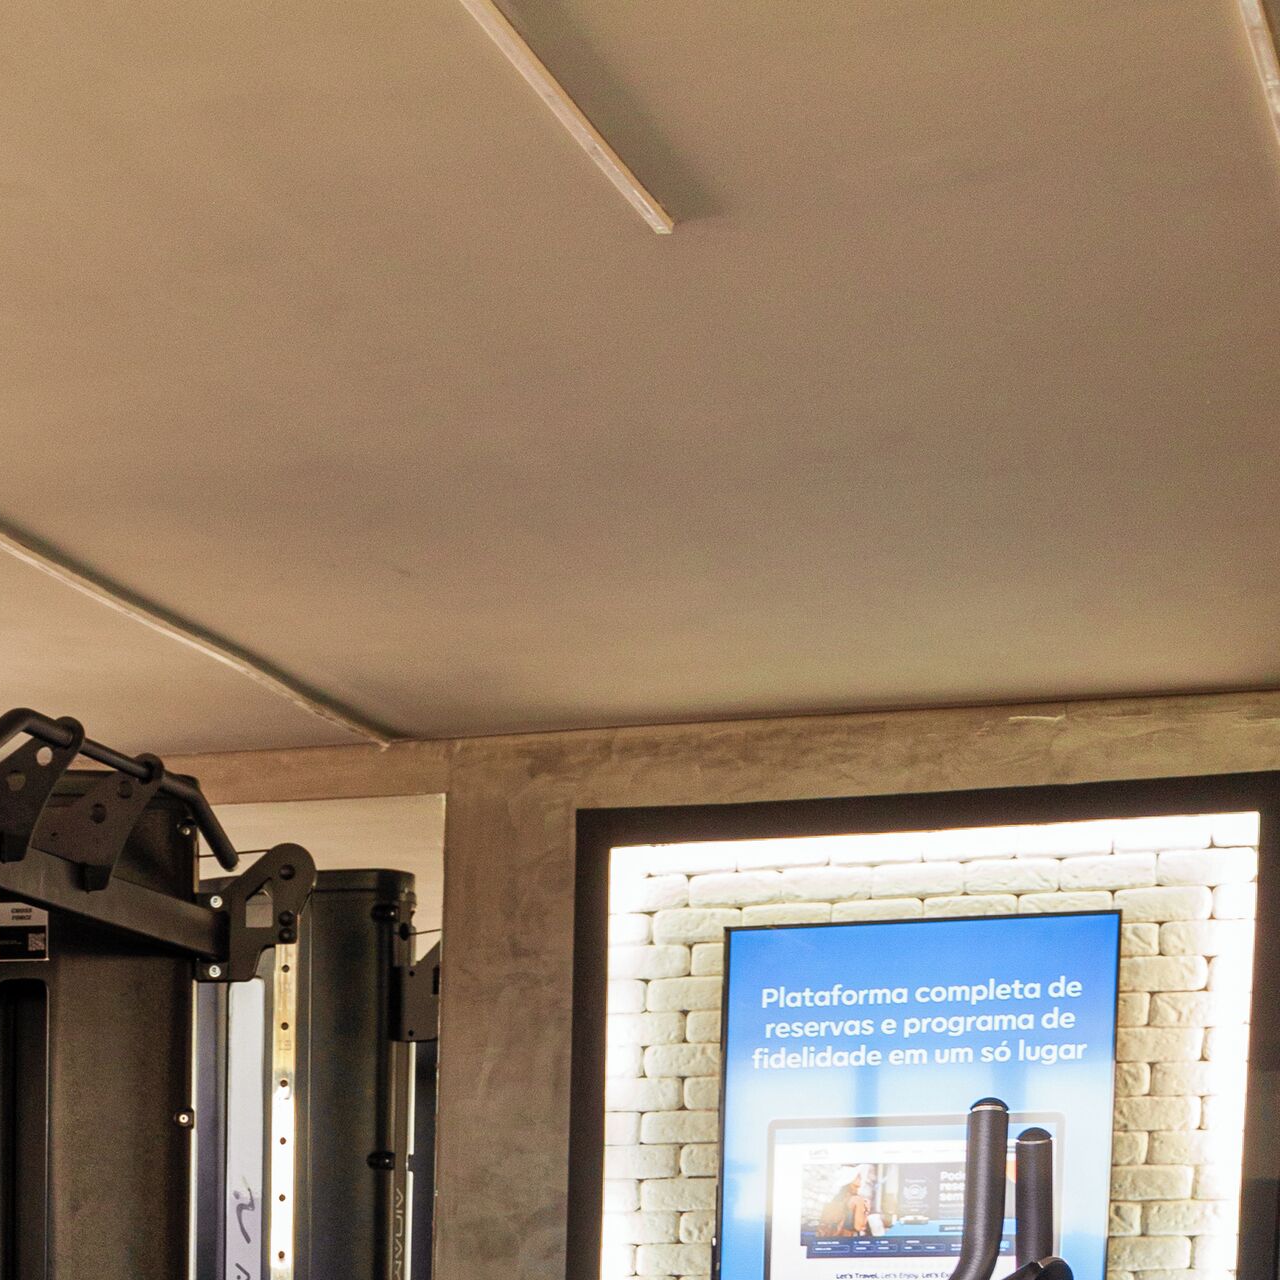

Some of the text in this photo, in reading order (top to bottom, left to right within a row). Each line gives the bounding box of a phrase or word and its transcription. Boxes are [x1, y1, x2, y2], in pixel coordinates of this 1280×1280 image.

[761, 975, 1083, 1009] Plataforma completa de
[765, 1006, 1076, 1039] reservas e programa de
[752, 1039, 1088, 1070] fidelidade em um só lugar
